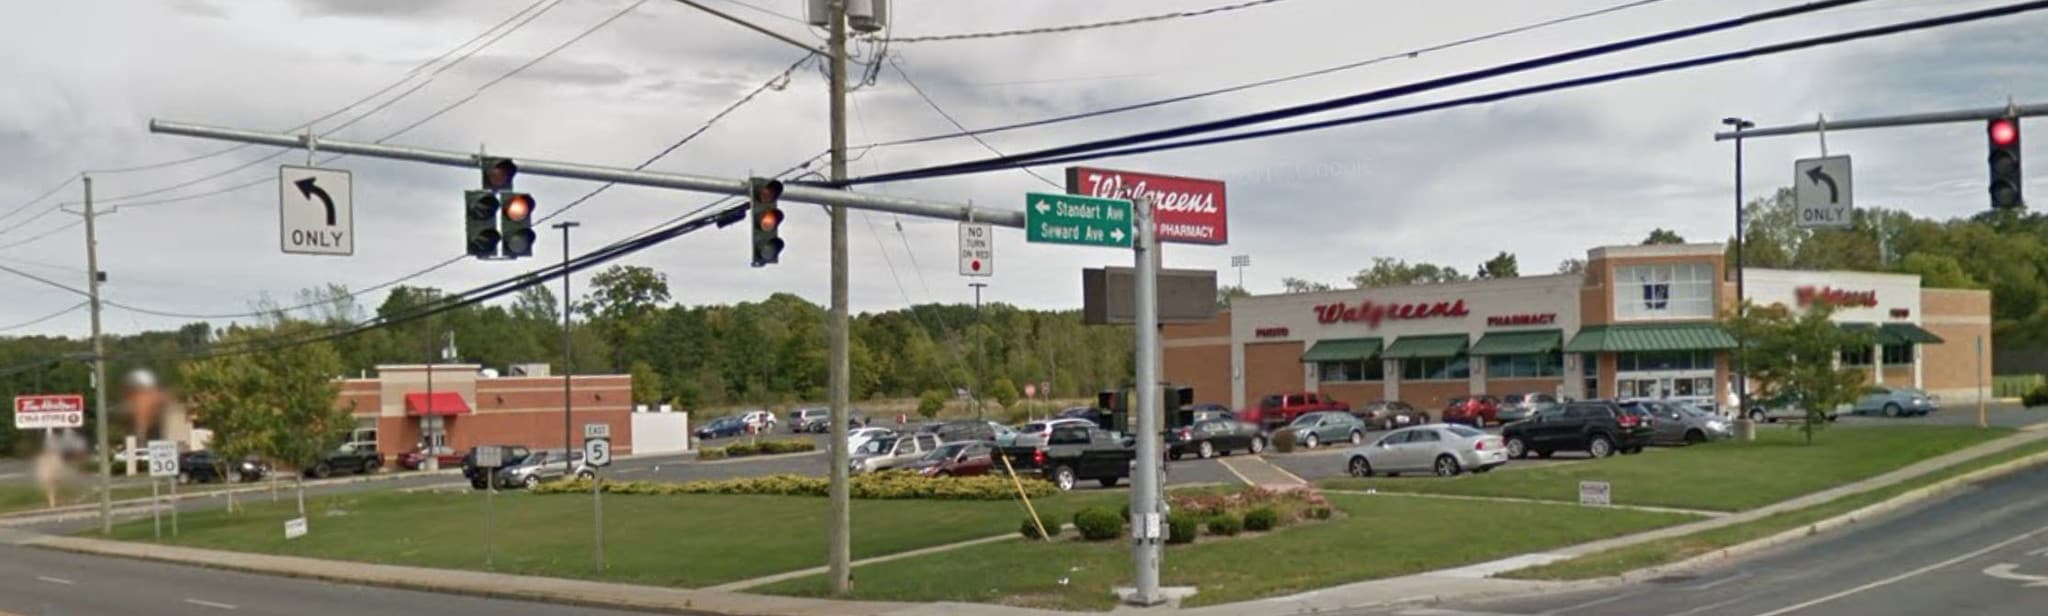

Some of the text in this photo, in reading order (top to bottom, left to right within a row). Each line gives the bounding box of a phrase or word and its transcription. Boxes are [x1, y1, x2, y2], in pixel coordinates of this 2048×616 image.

[1089, 174, 1218, 213] Wlreens
[1056, 201, 1124, 220] Standart Ave
[1803, 208, 1845, 222] ONLY
[291, 229, 344, 247] ONLY
[967, 226, 983, 238] NO
[1041, 222, 1104, 241] Seward Ave
[1160, 223, 1214, 238] PHARMACY
[966, 239, 986, 248] TURN
[963, 249, 989, 259] ON RED
[1313, 299, 1470, 329] Walgreens
[1487, 312, 1557, 327] PHARMACY
[593, 443, 604, 460] 5
[153, 460, 176, 472] 30
